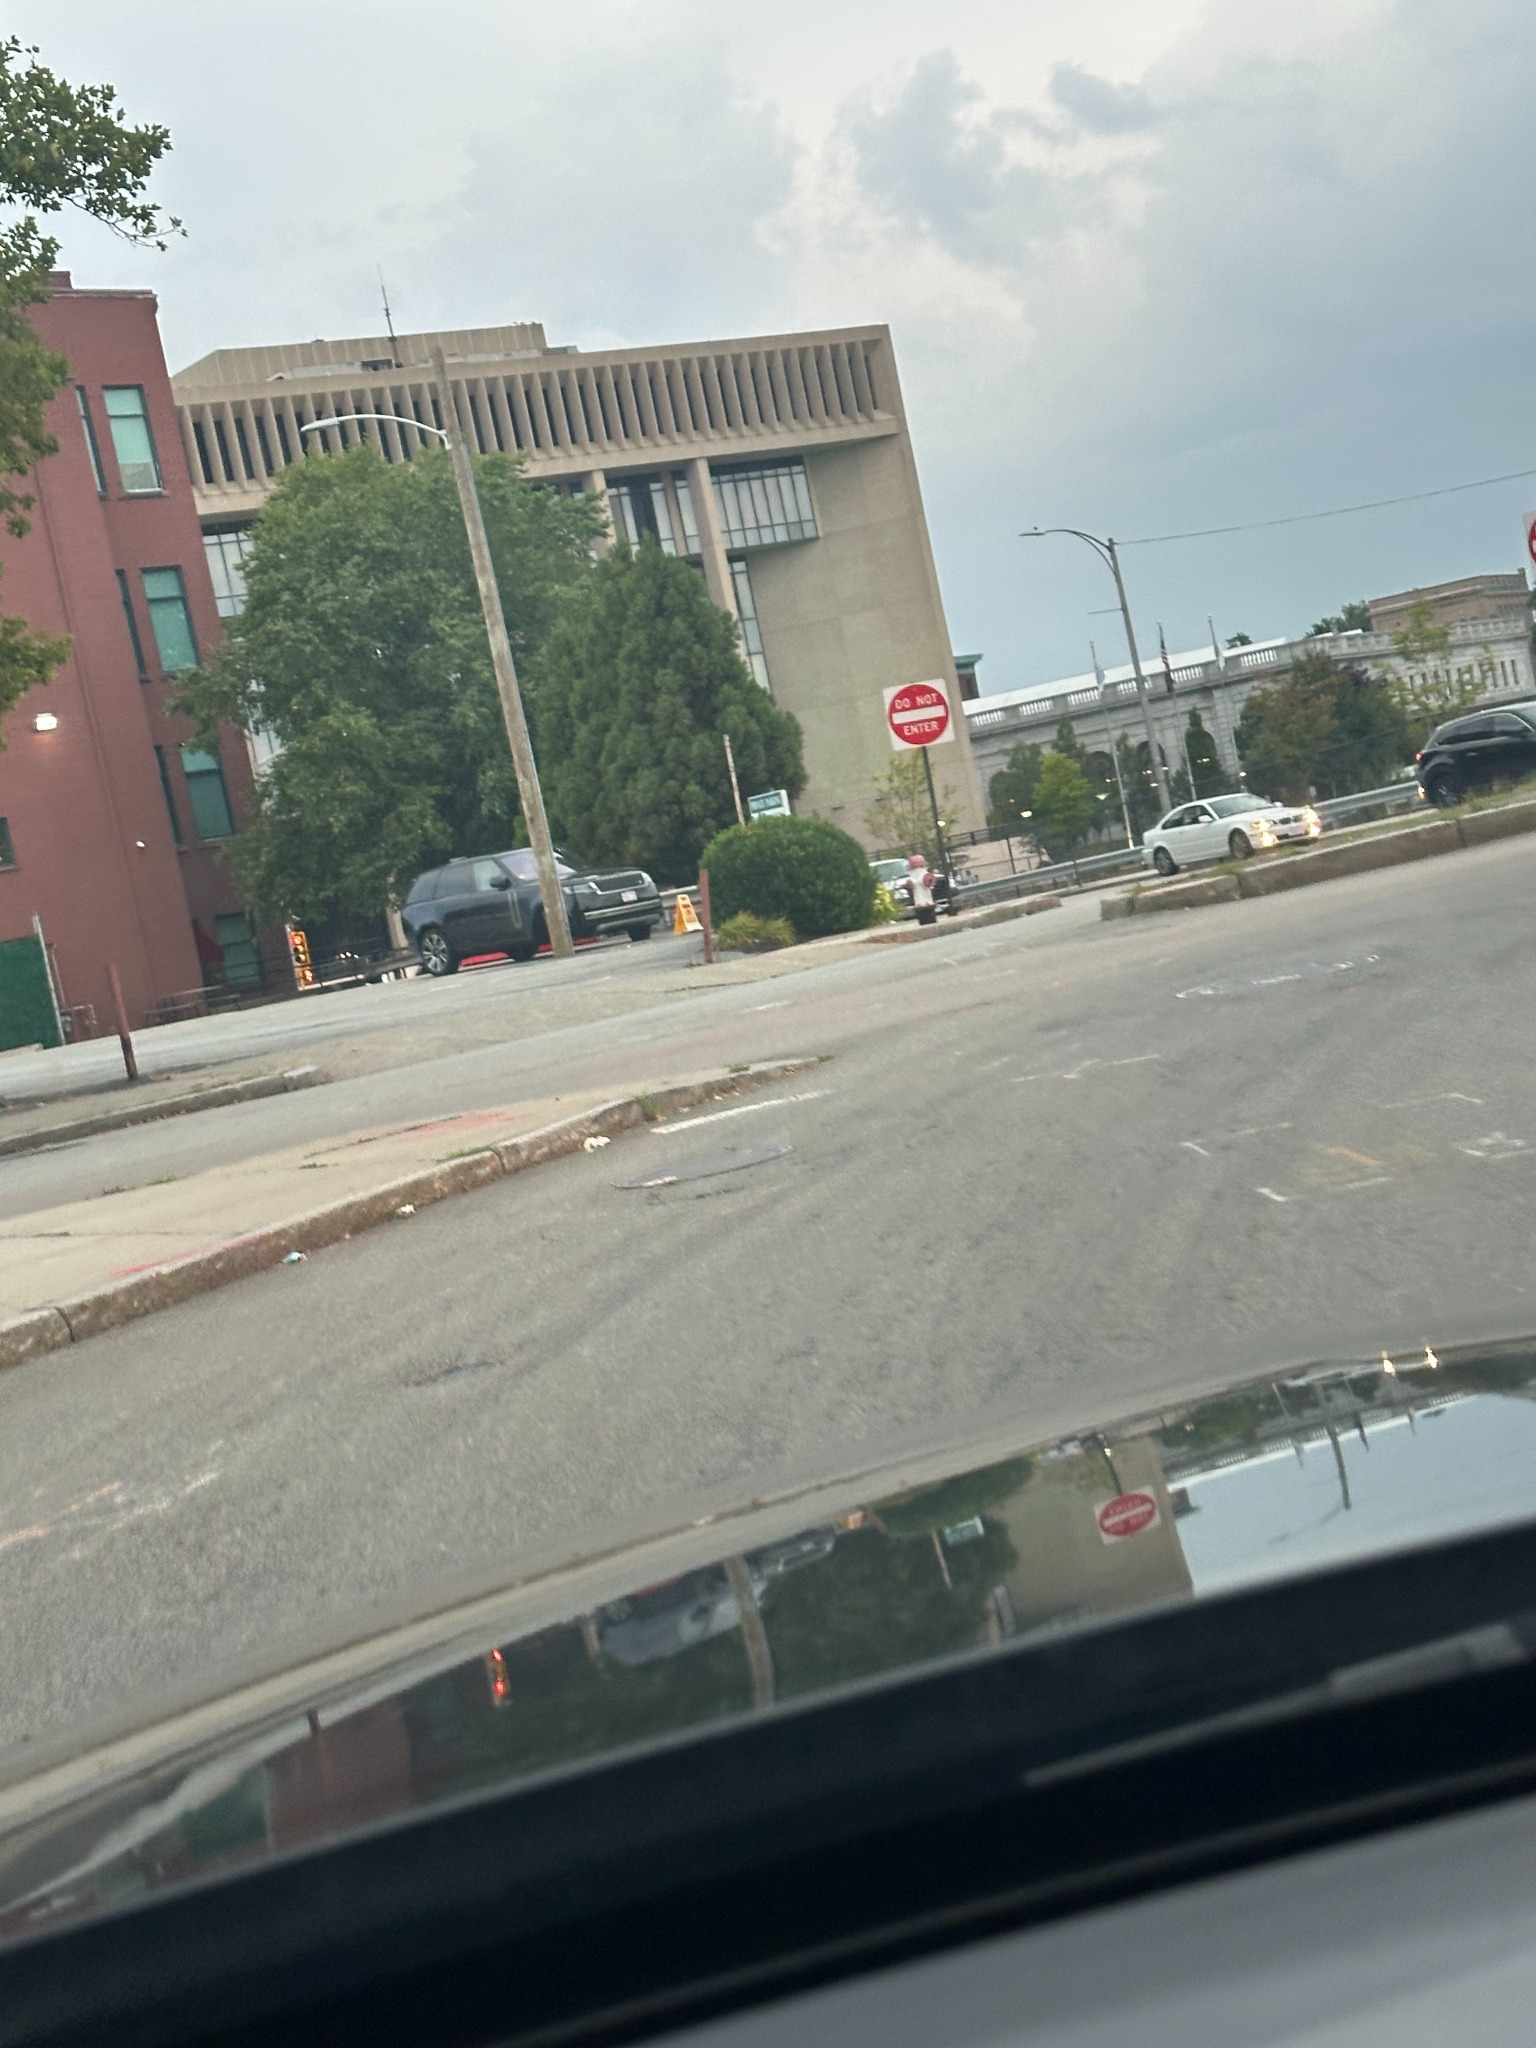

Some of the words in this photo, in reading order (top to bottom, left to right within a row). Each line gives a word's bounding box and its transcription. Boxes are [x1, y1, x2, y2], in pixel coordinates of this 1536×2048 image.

[894, 697, 911, 709] DO
[915, 693, 938, 706] NOT
[903, 721, 939, 735] ENTER
